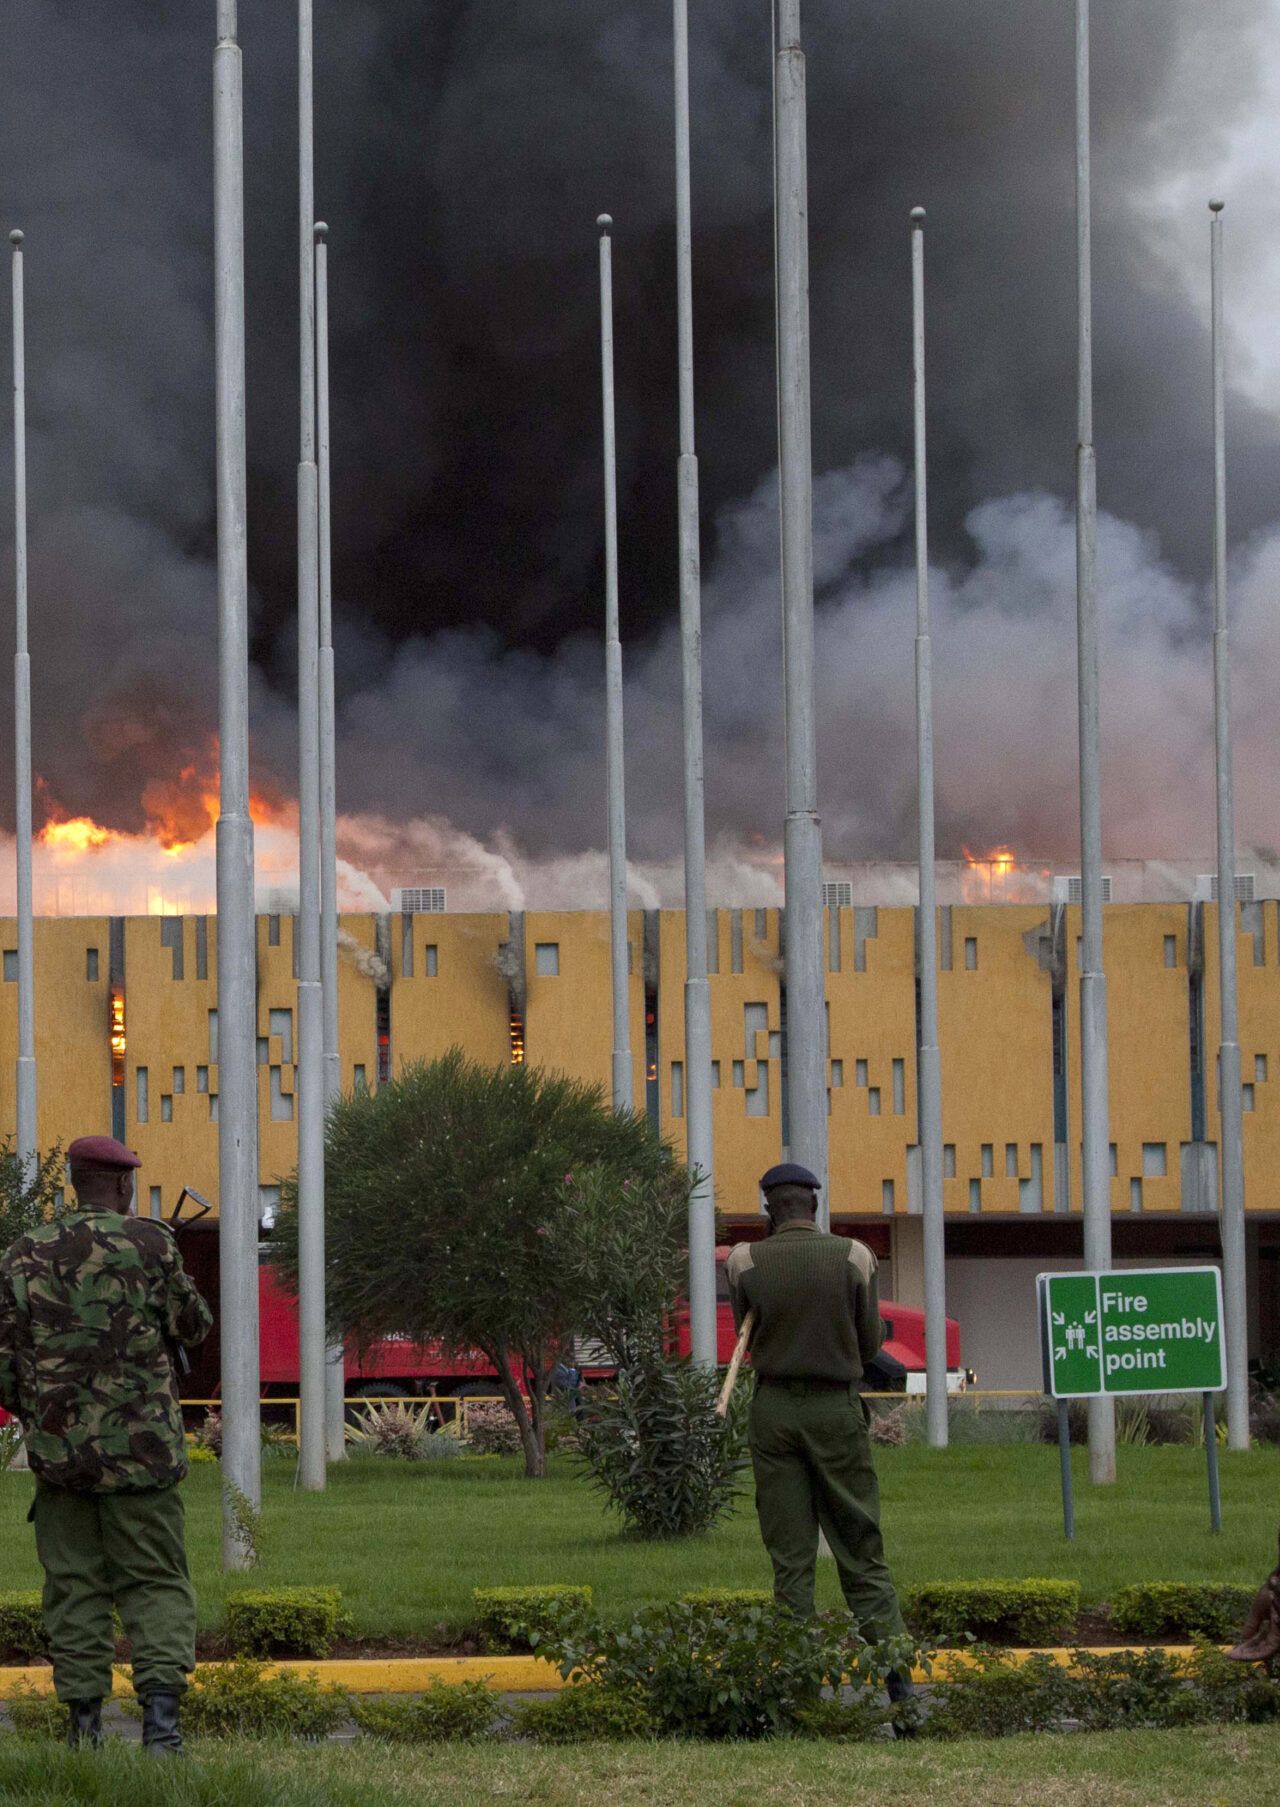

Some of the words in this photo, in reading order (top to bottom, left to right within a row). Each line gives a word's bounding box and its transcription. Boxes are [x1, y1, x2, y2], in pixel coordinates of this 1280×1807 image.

[1102, 1291, 1148, 1313] Fire
[1104, 1317, 1216, 1343] assembly
[1106, 1348, 1167, 1376] point
